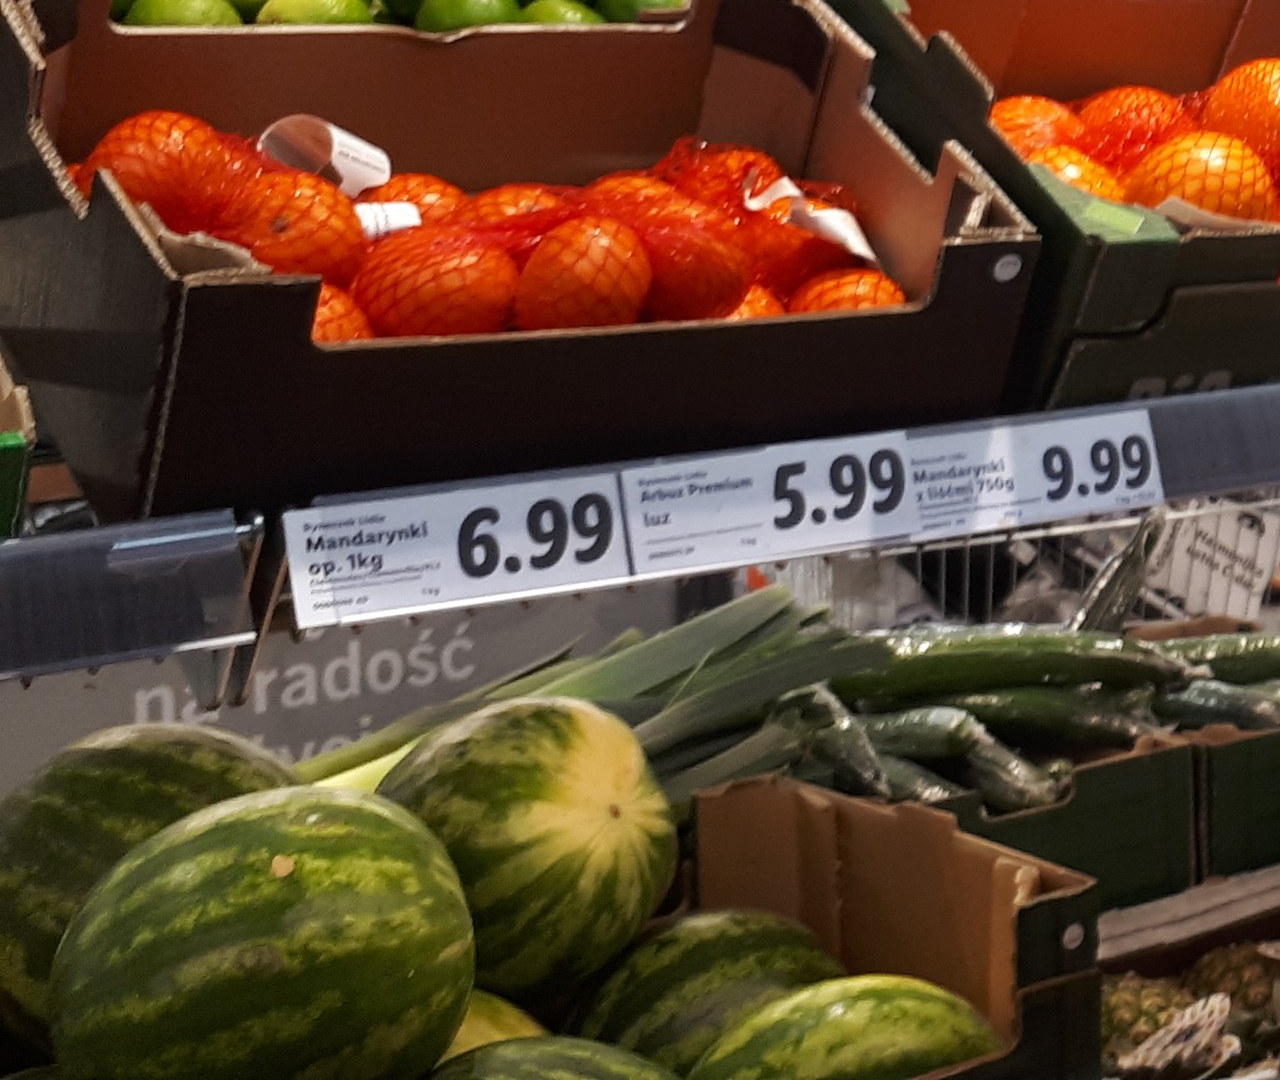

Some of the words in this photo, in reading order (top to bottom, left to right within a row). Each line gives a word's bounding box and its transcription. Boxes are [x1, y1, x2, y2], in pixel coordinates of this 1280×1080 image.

[773, 447, 906, 532] 5.99
[1042, 432, 1151, 502] 9.99
[305, 520, 429, 553] Mandarynki
[308, 560, 343, 577] op.
[345, 551, 384, 571] 1kg
[457, 492, 614, 578] 6.99
[251, 621, 477, 715] radość
